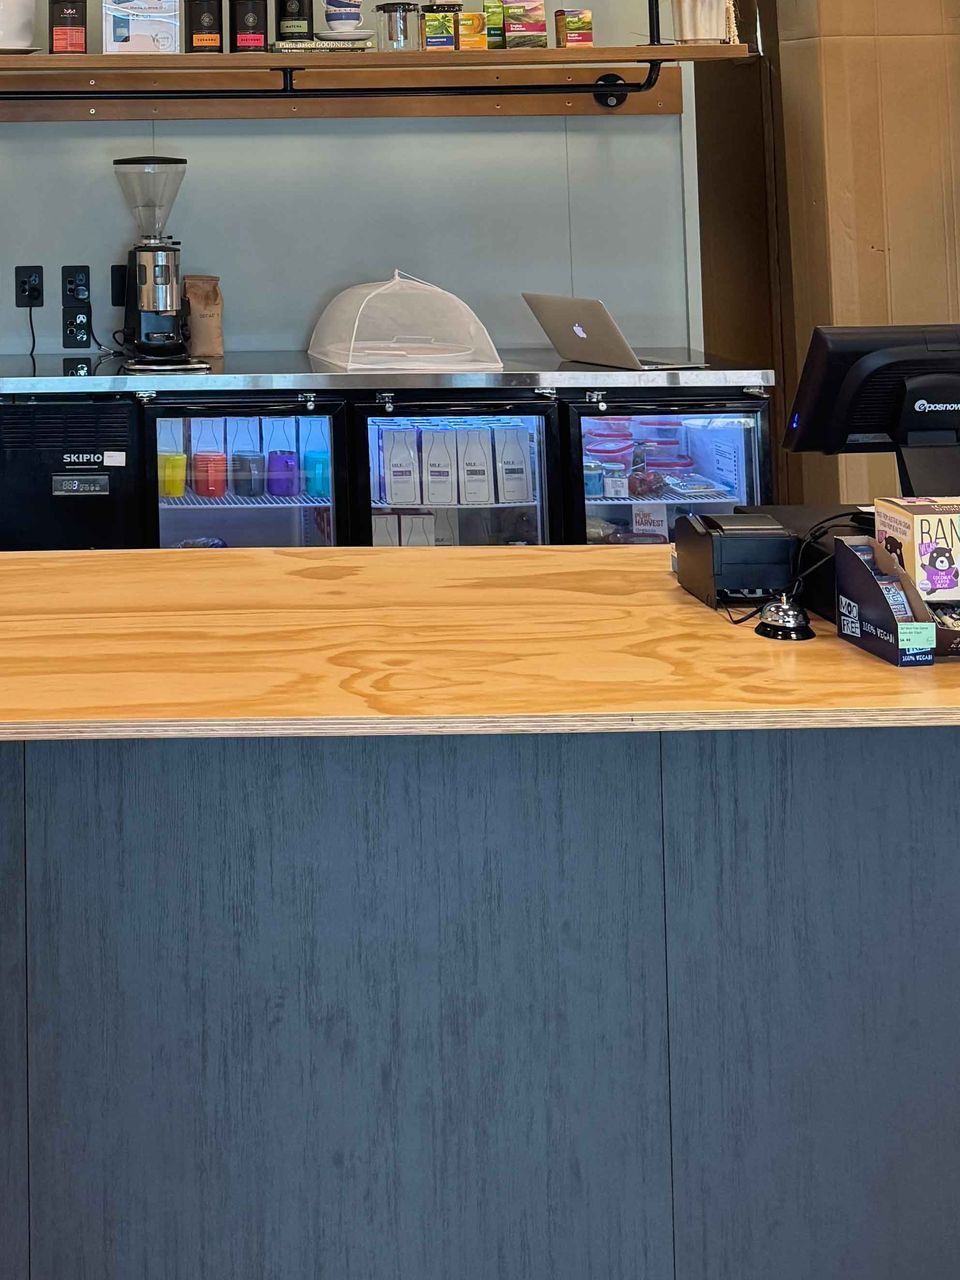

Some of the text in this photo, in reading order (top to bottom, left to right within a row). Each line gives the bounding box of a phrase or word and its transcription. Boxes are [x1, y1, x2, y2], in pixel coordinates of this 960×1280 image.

[316, 40, 352, 48] GOODNESS
[63, 453, 103, 463] SKIPIO
[635, 519, 664, 527] HARVEST
[839, 596, 858, 620] MOO
[842, 618, 860, 636] FREE
[862, 622, 876, 636] 100%
